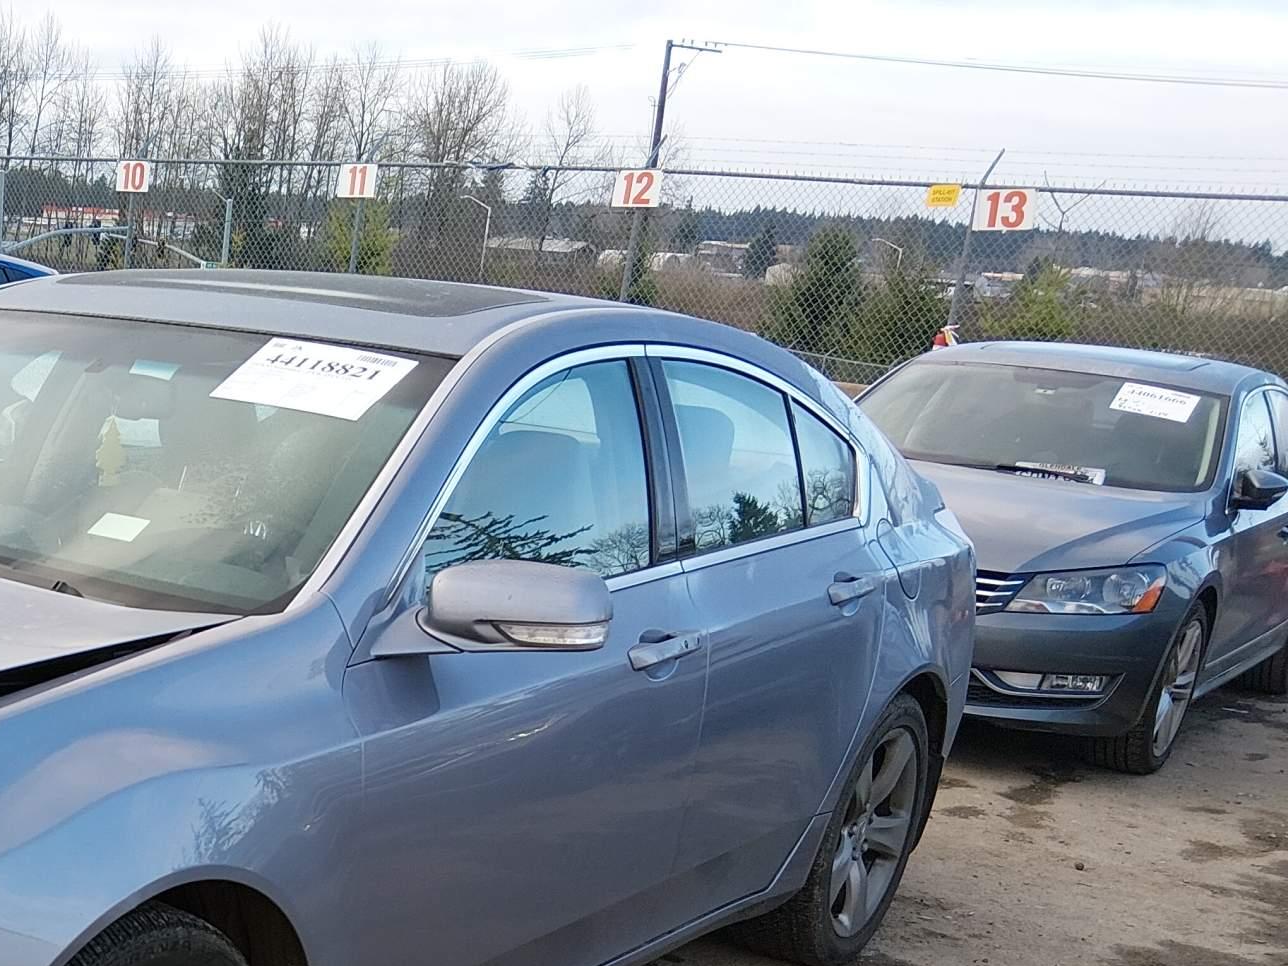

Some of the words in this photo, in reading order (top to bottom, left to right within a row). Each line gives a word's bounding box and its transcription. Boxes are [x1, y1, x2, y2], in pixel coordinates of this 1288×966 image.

[122, 162, 145, 190] 10
[348, 166, 368, 195] 11
[622, 172, 655, 205] 12
[987, 190, 1027, 228] 13
[266, 353, 382, 381] 44118821
